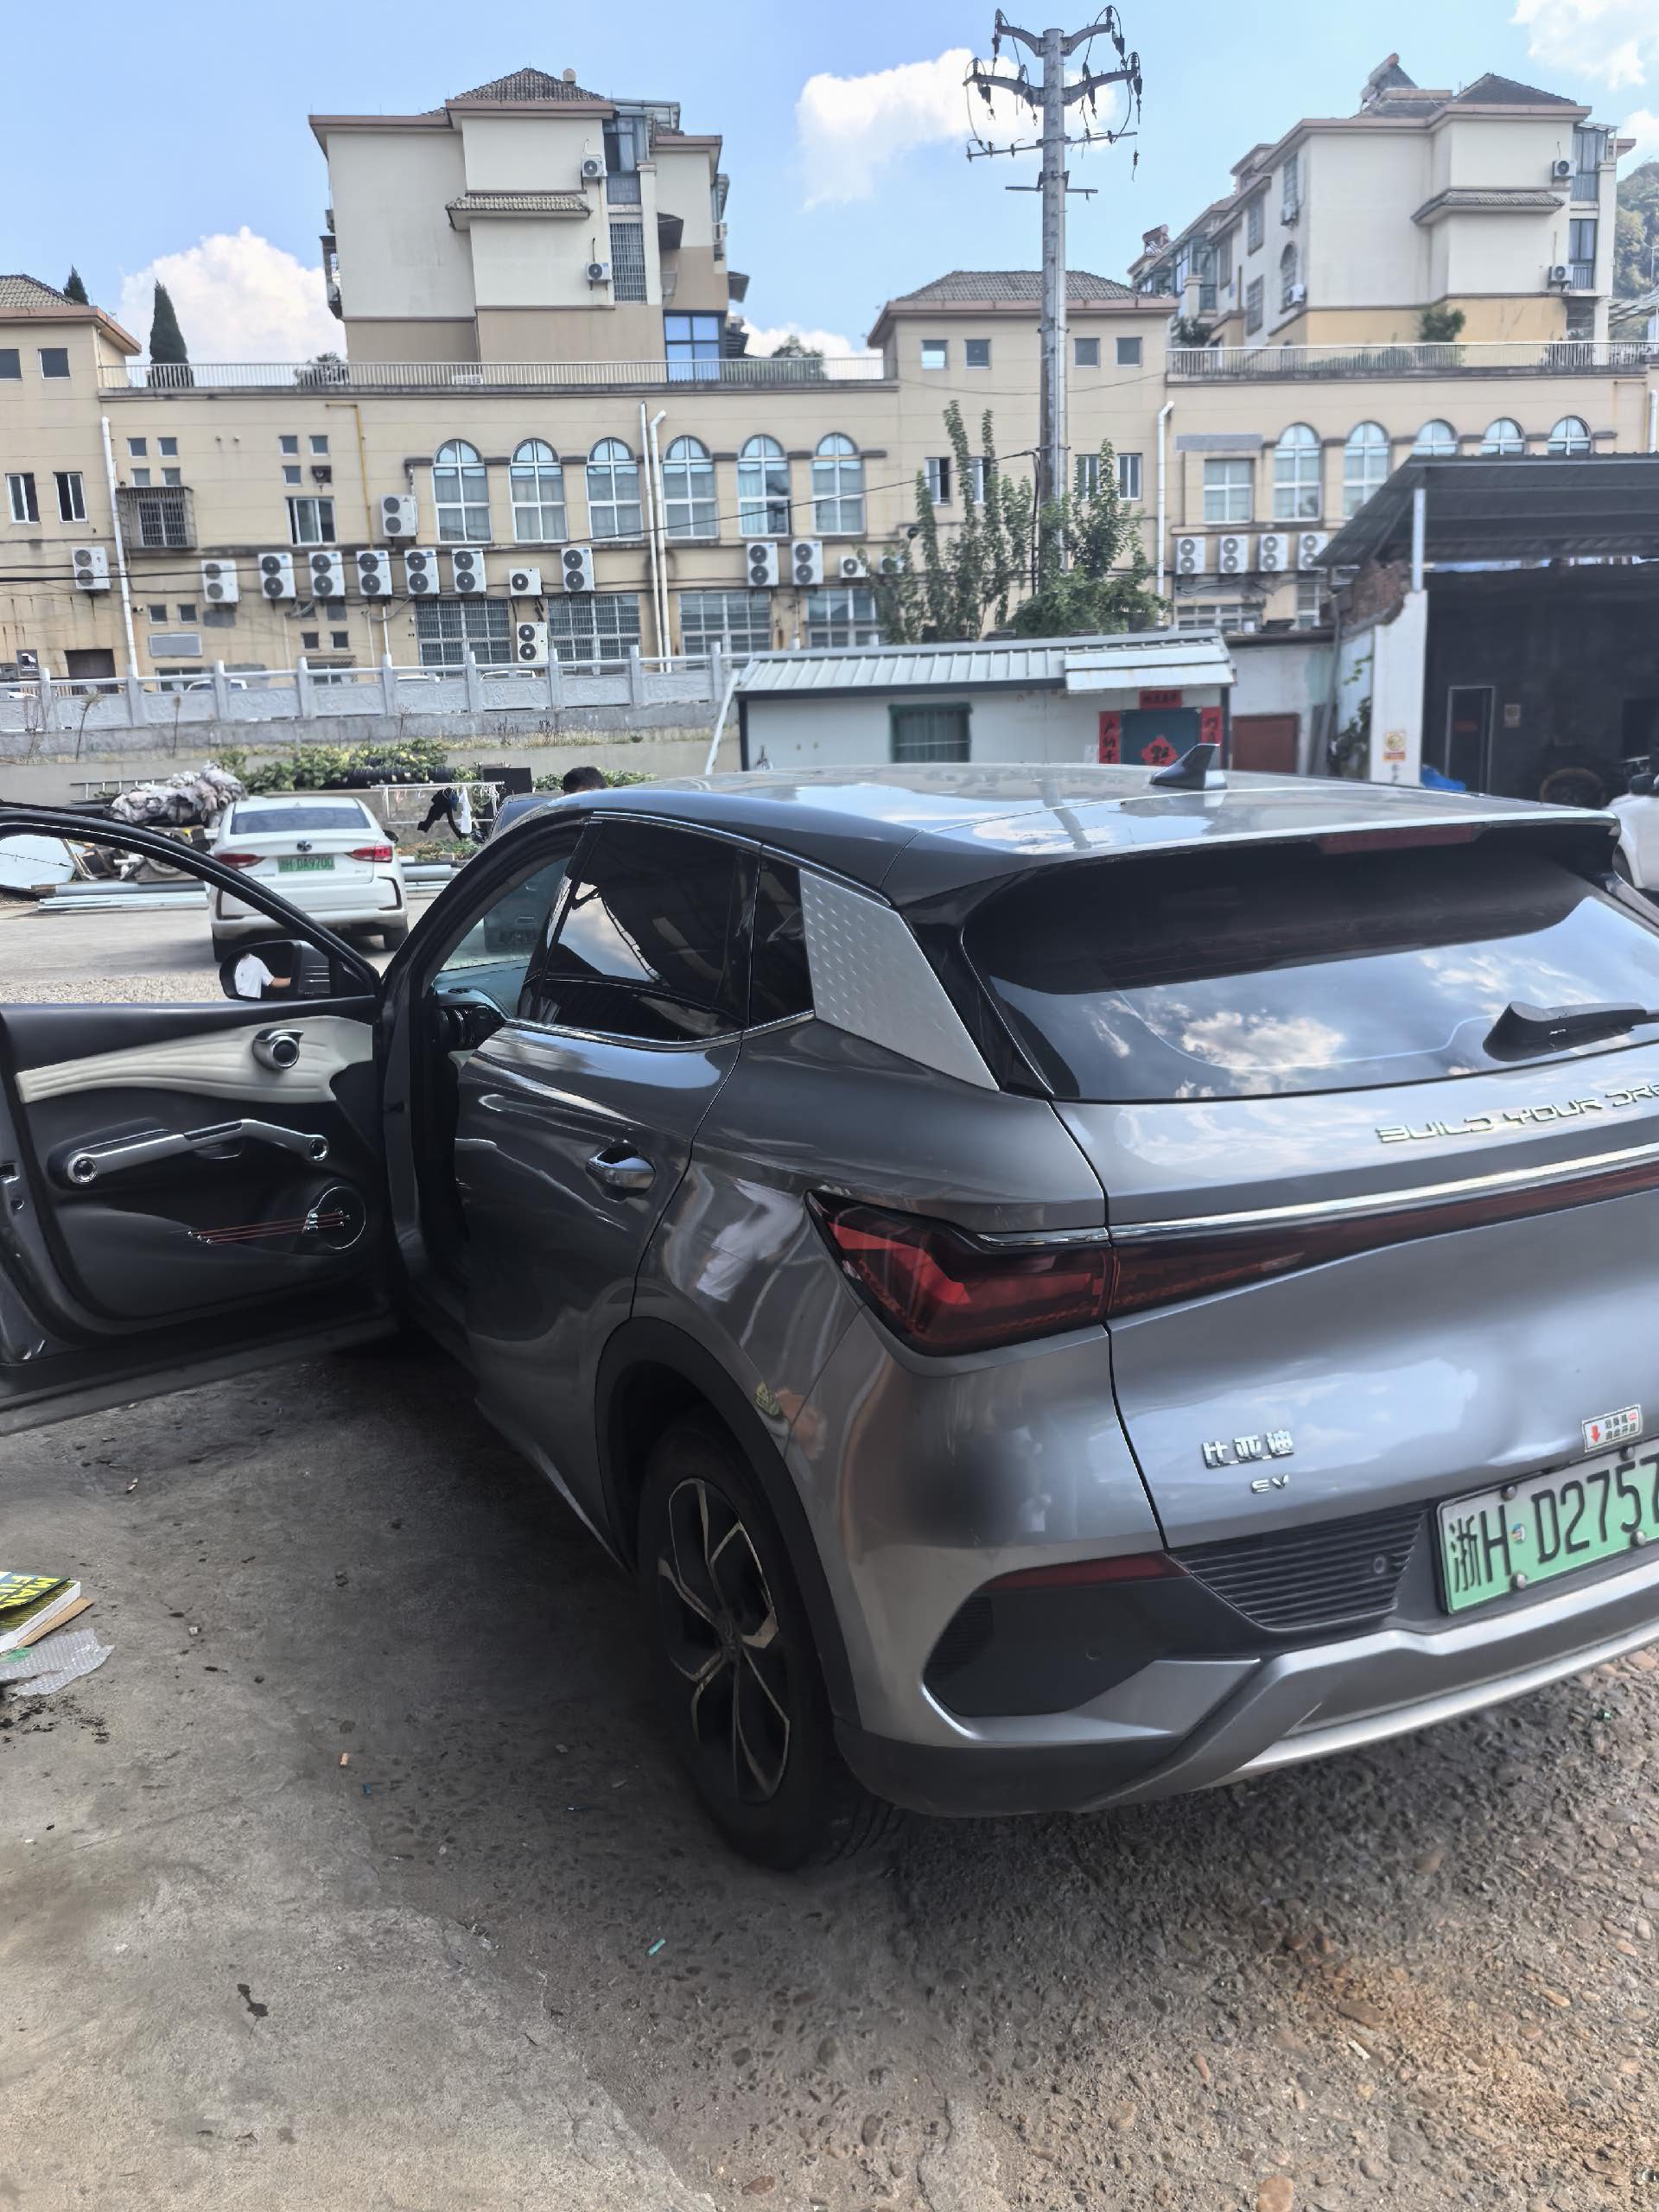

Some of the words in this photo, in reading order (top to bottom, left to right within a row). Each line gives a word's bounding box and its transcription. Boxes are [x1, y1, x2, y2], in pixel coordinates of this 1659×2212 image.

[1375, 1116, 1493, 1144] BUILD
[1502, 1096, 1603, 1125] YOUR
[1250, 1474, 1289, 1494] EV
